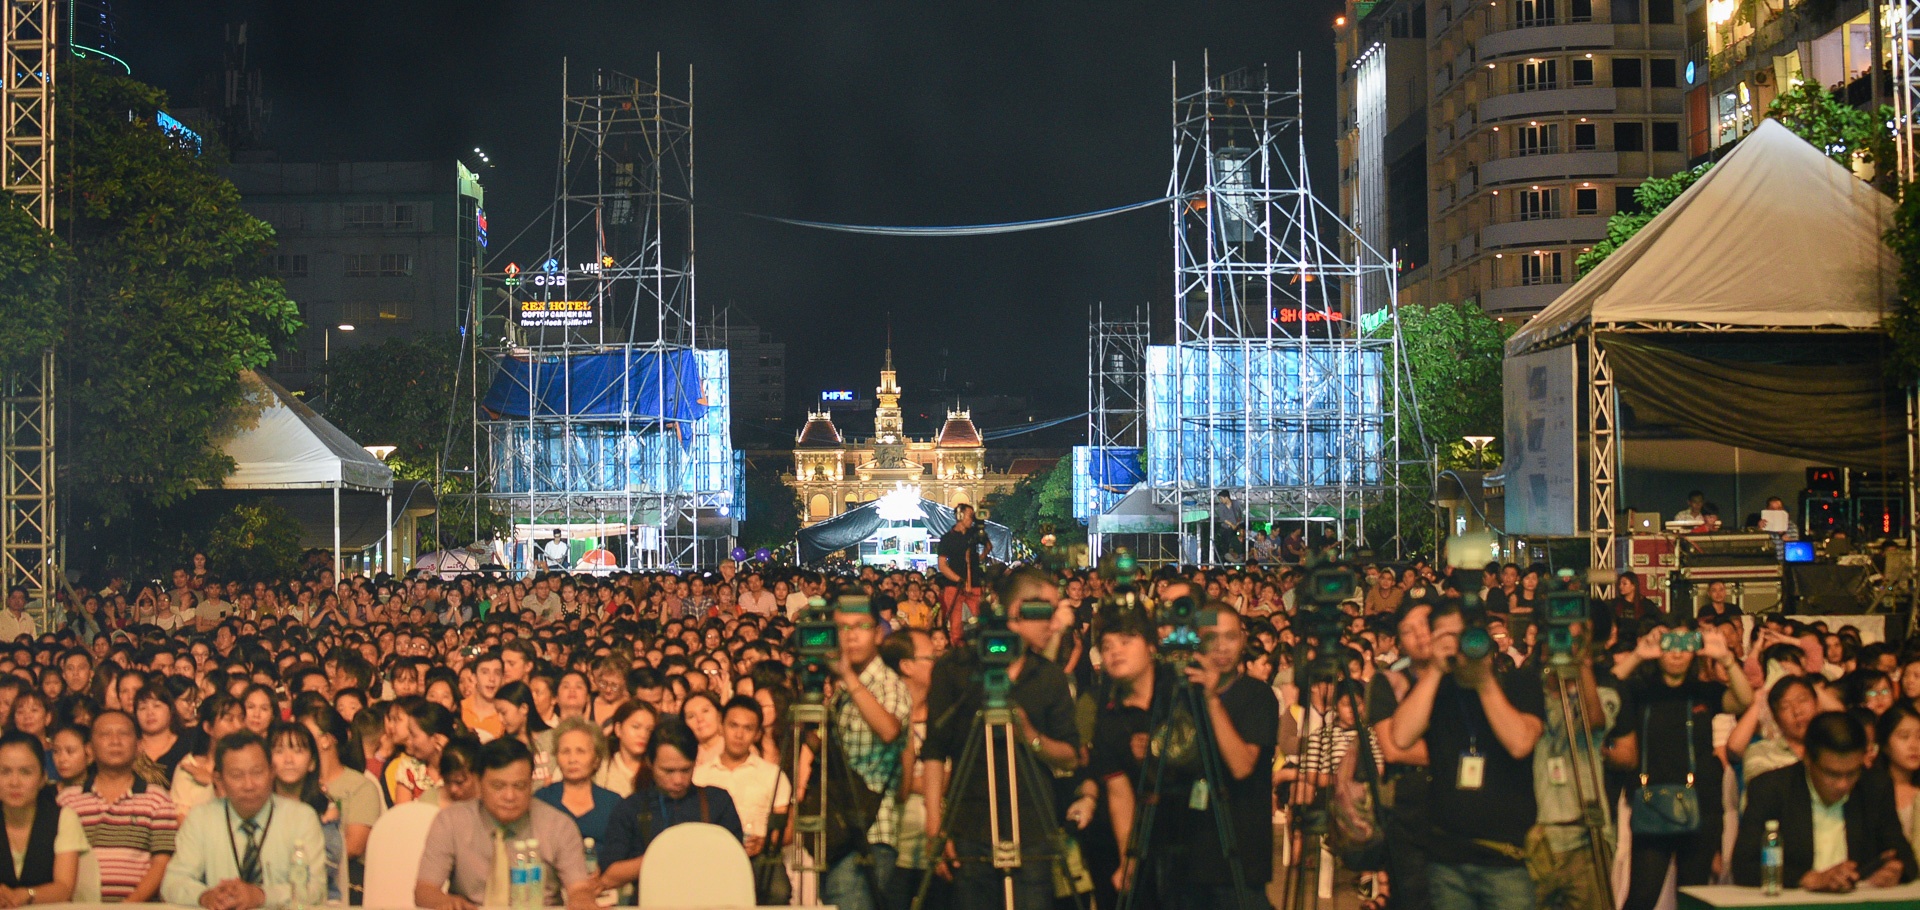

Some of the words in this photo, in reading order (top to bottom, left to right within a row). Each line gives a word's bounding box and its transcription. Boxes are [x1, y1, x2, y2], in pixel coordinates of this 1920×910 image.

[521, 301, 546, 311] REX
[549, 301, 592, 311] HOTEL
[1280, 307, 1297, 322] SH
